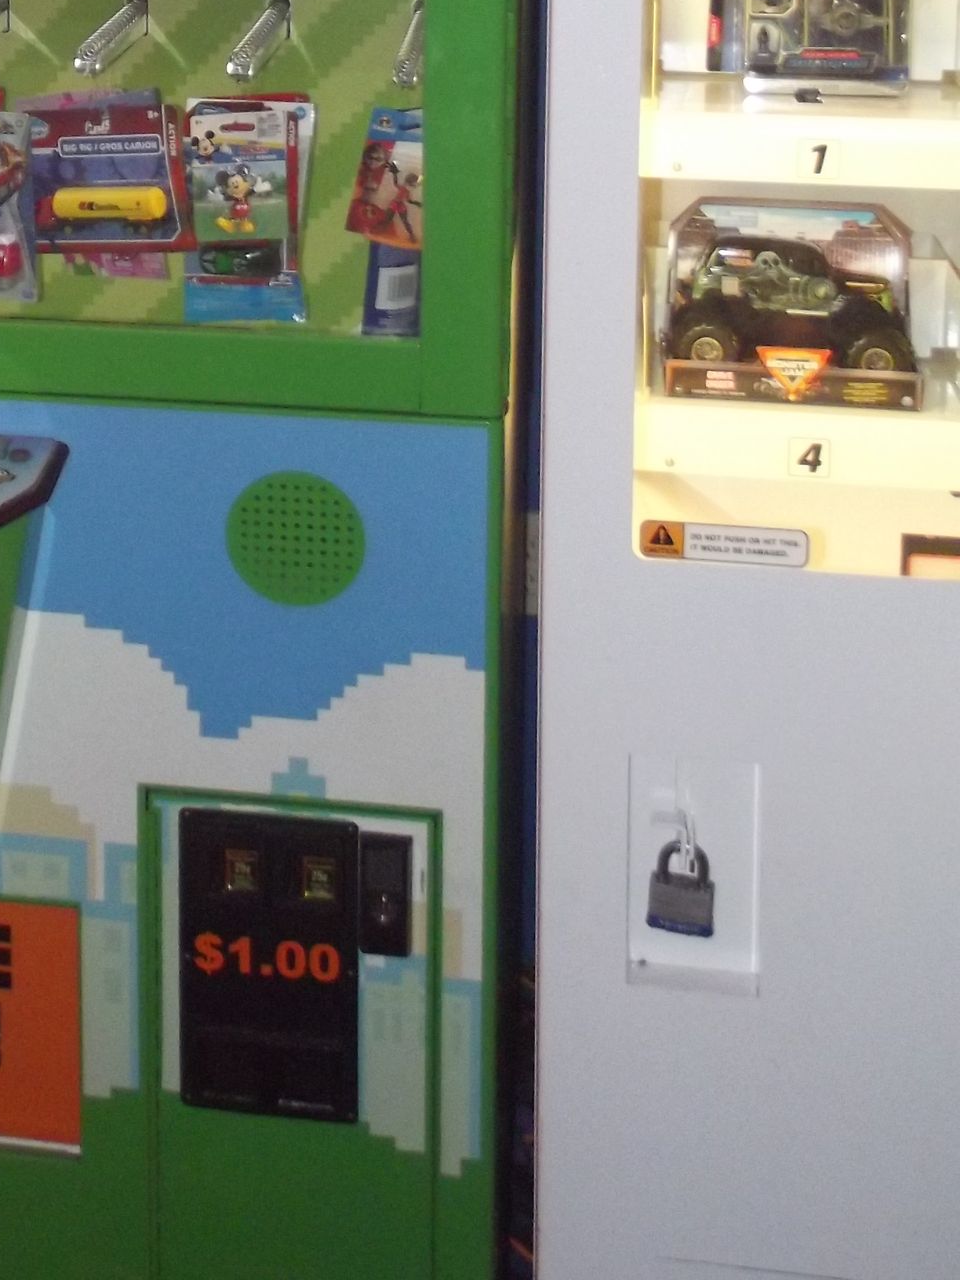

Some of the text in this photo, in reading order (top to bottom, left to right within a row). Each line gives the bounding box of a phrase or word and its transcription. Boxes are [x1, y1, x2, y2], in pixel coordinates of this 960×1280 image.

[167, 122, 177, 157] ACTION
[811, 144, 828, 174] 1
[797, 443, 823, 473] 4
[193, 930, 341, 985] $1.00
